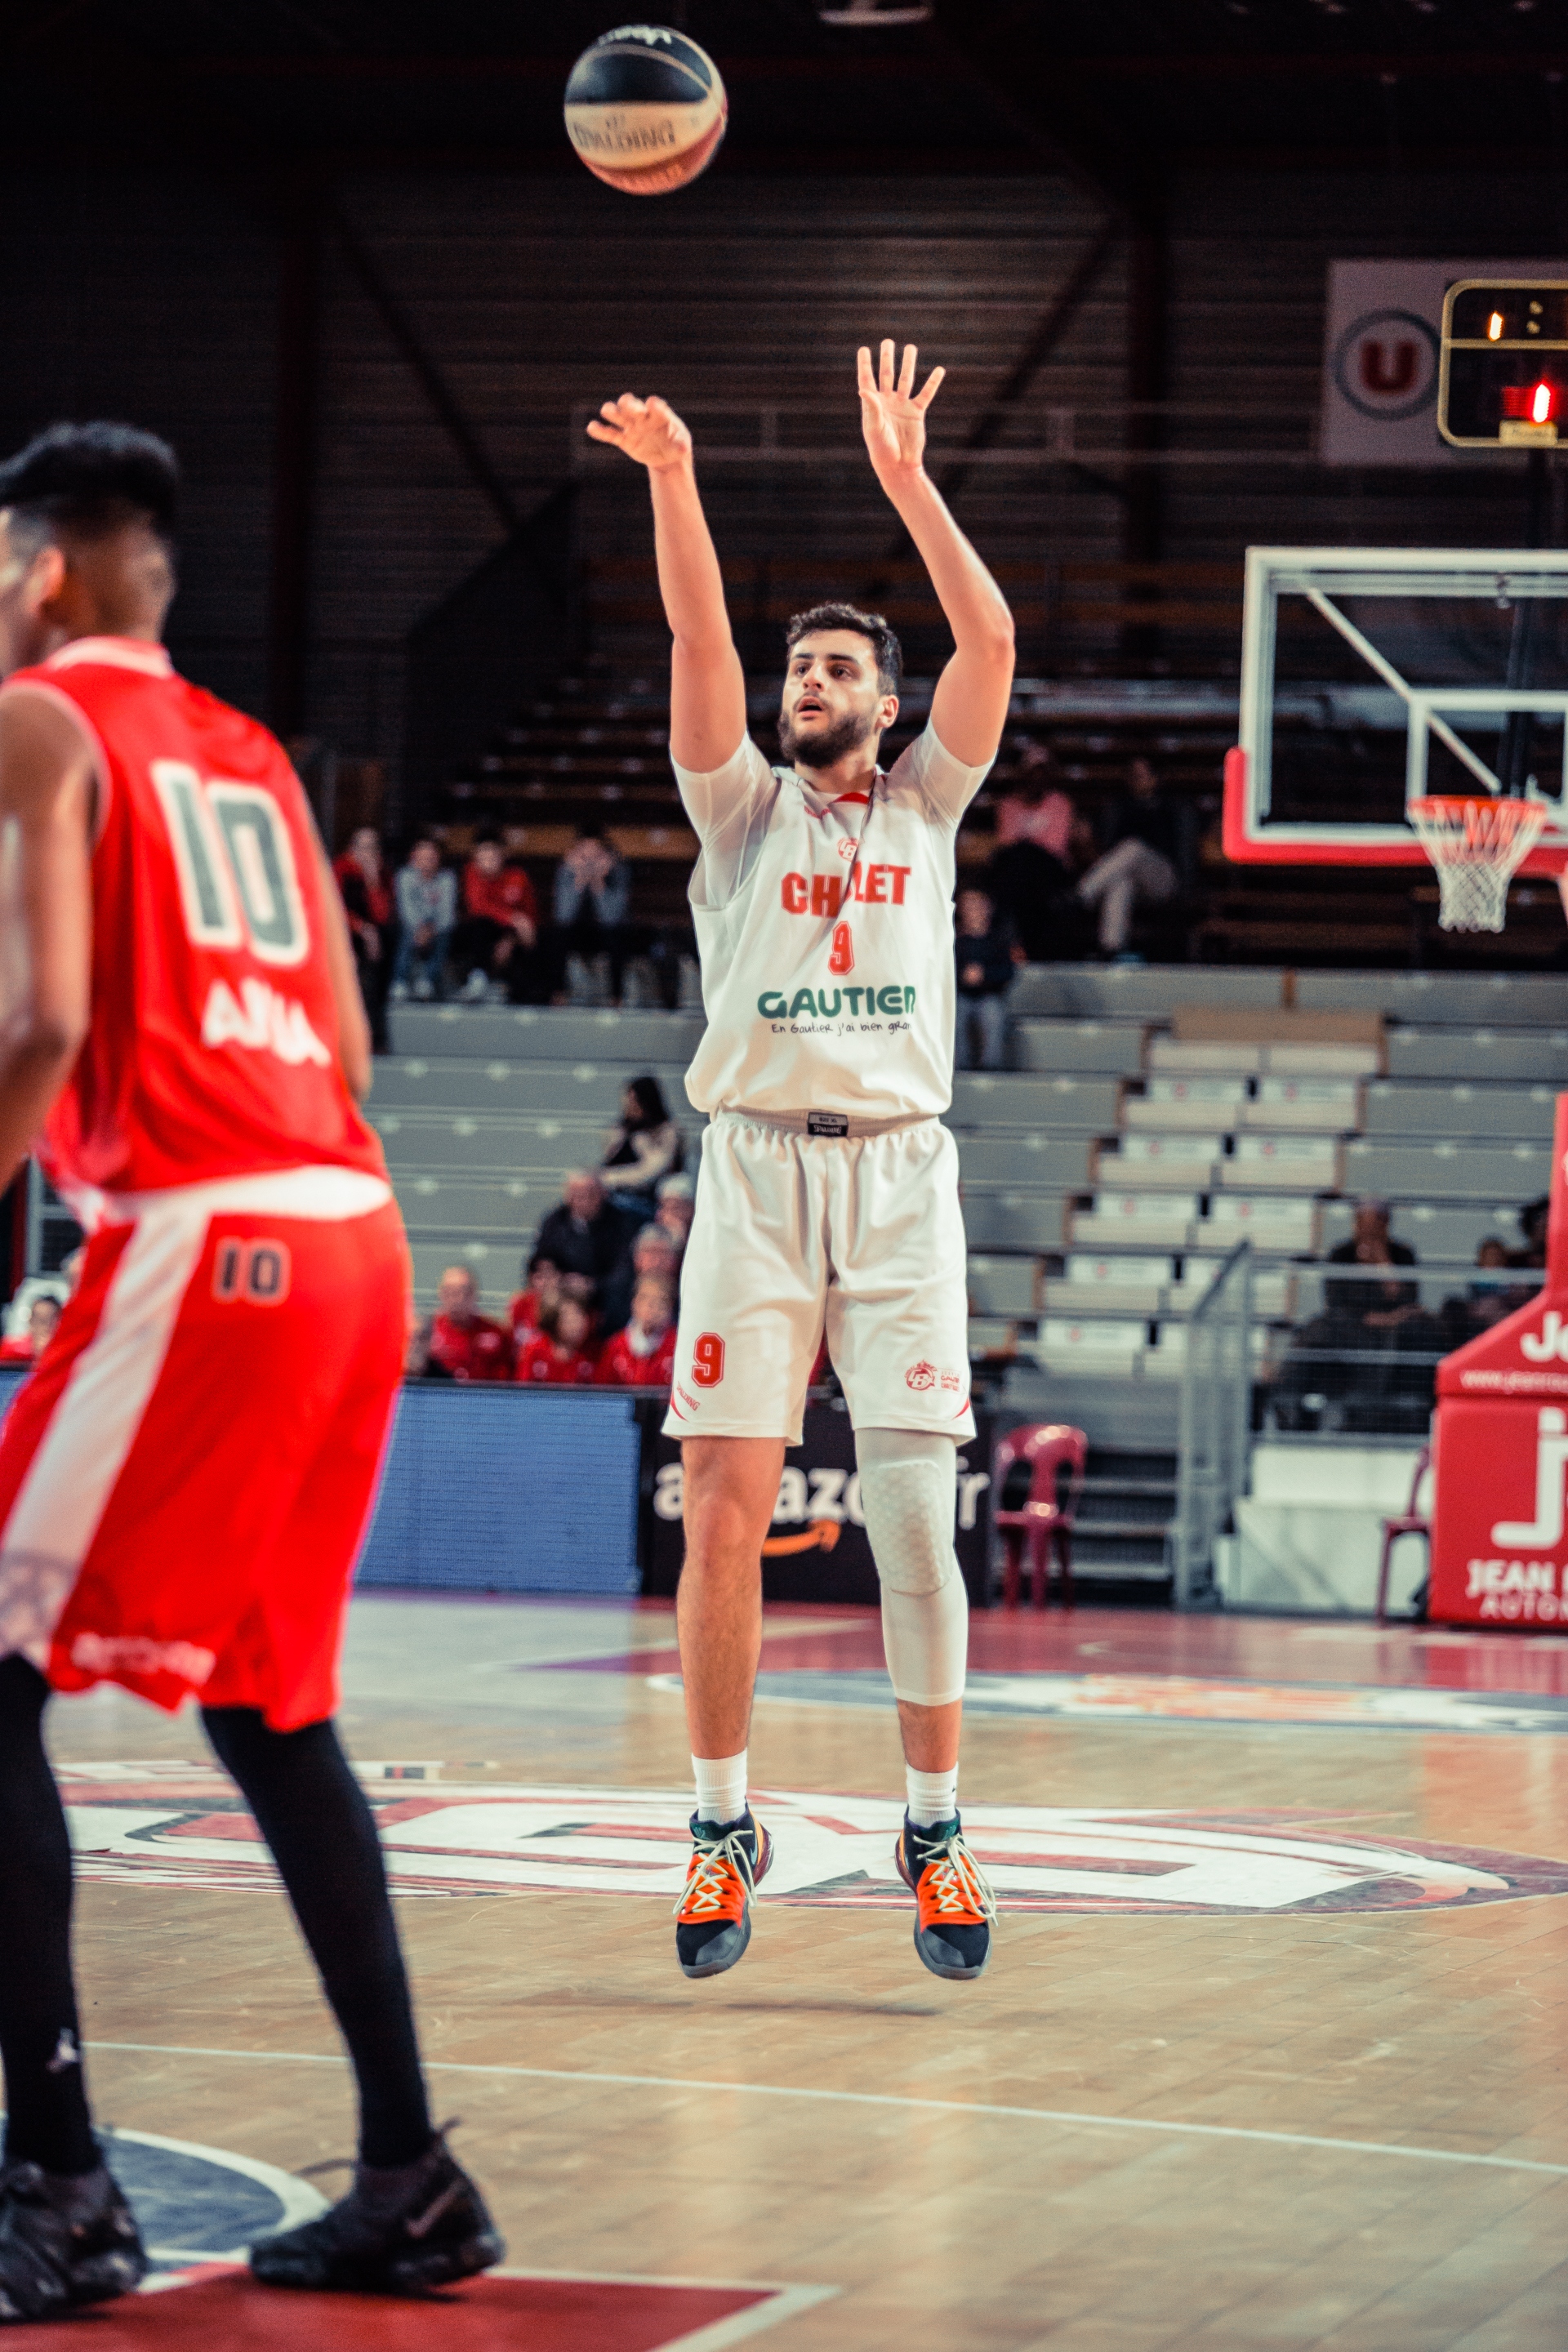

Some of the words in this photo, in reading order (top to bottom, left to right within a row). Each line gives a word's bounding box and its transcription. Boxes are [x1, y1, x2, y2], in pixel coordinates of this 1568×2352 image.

[1359, 337, 1419, 399] U
[150, 760, 310, 967] 10
[780, 861, 911, 919] CHLET
[828, 920, 855, 976] 9
[771, 1023, 786, 1033] En
[860, 1022, 883, 1031] bien
[216, 1241, 287, 1303] 10
[691, 1331, 726, 1388] 9
[1466, 1559, 1556, 1598] JEAN
